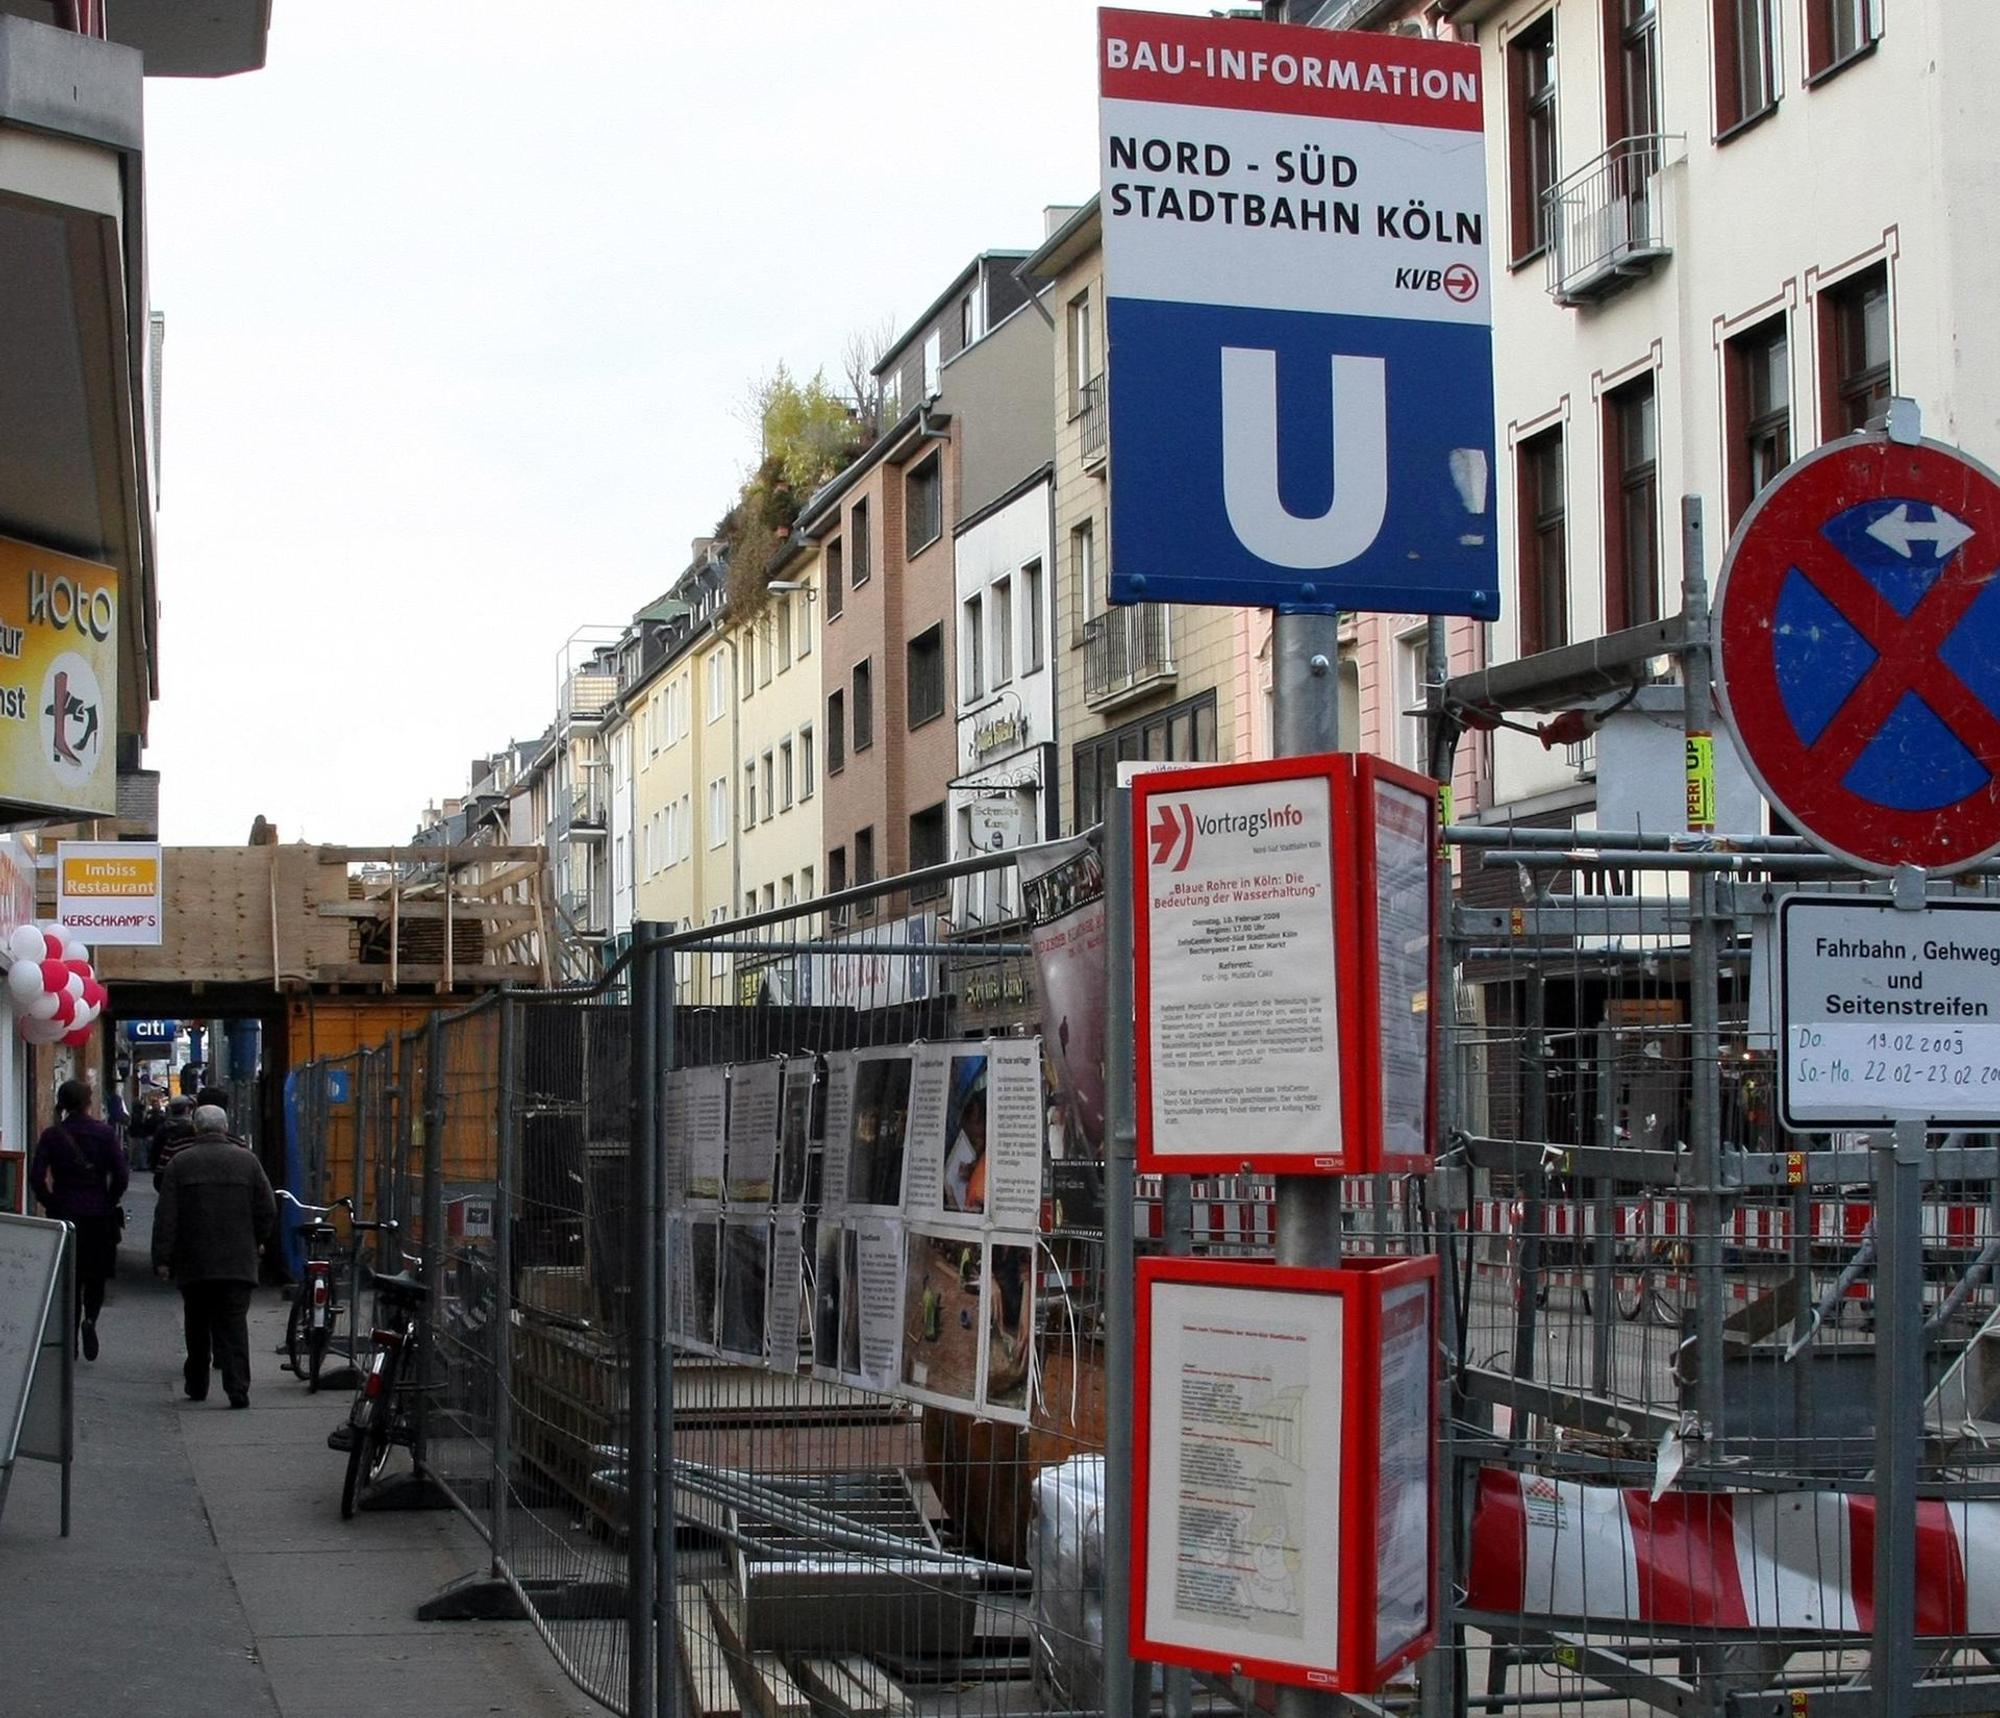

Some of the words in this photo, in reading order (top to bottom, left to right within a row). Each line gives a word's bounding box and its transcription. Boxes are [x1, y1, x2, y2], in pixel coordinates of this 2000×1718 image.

[1106, 38, 1477, 102] BAU-INFORMATION
[1110, 136, 1231, 177] NORD
[1275, 144, 1357, 188] SÜD
[1111, 183, 1359, 235] STADTBAHN
[1377, 200, 1482, 245] KÖLN
[1395, 267, 1442, 292] KVB
[1221, 346, 1387, 569] U
[1686, 739, 1699, 770] UP
[1687, 778, 1700, 815] PERI
[1196, 804, 1303, 837] VortragsInfo
[86, 863, 137, 877] Imbiss
[1207, 878, 1238, 892] Rohre
[1240, 877, 1251, 888] in
[1254, 875, 1282, 888] Köln:
[1285, 872, 1304, 885] Die
[67, 880, 154, 894] Restaurant
[1154, 893, 1210, 909] Bedeutung
[1213, 891, 1230, 904] der
[1816, 938, 1906, 959] Fahrbahn
[1924, 940, 2000, 966] Gehweg
[1887, 971, 1922, 989] und
[1826, 994, 1988, 1016] Seitenstreifen
[136, 1020, 165, 1036] citi
